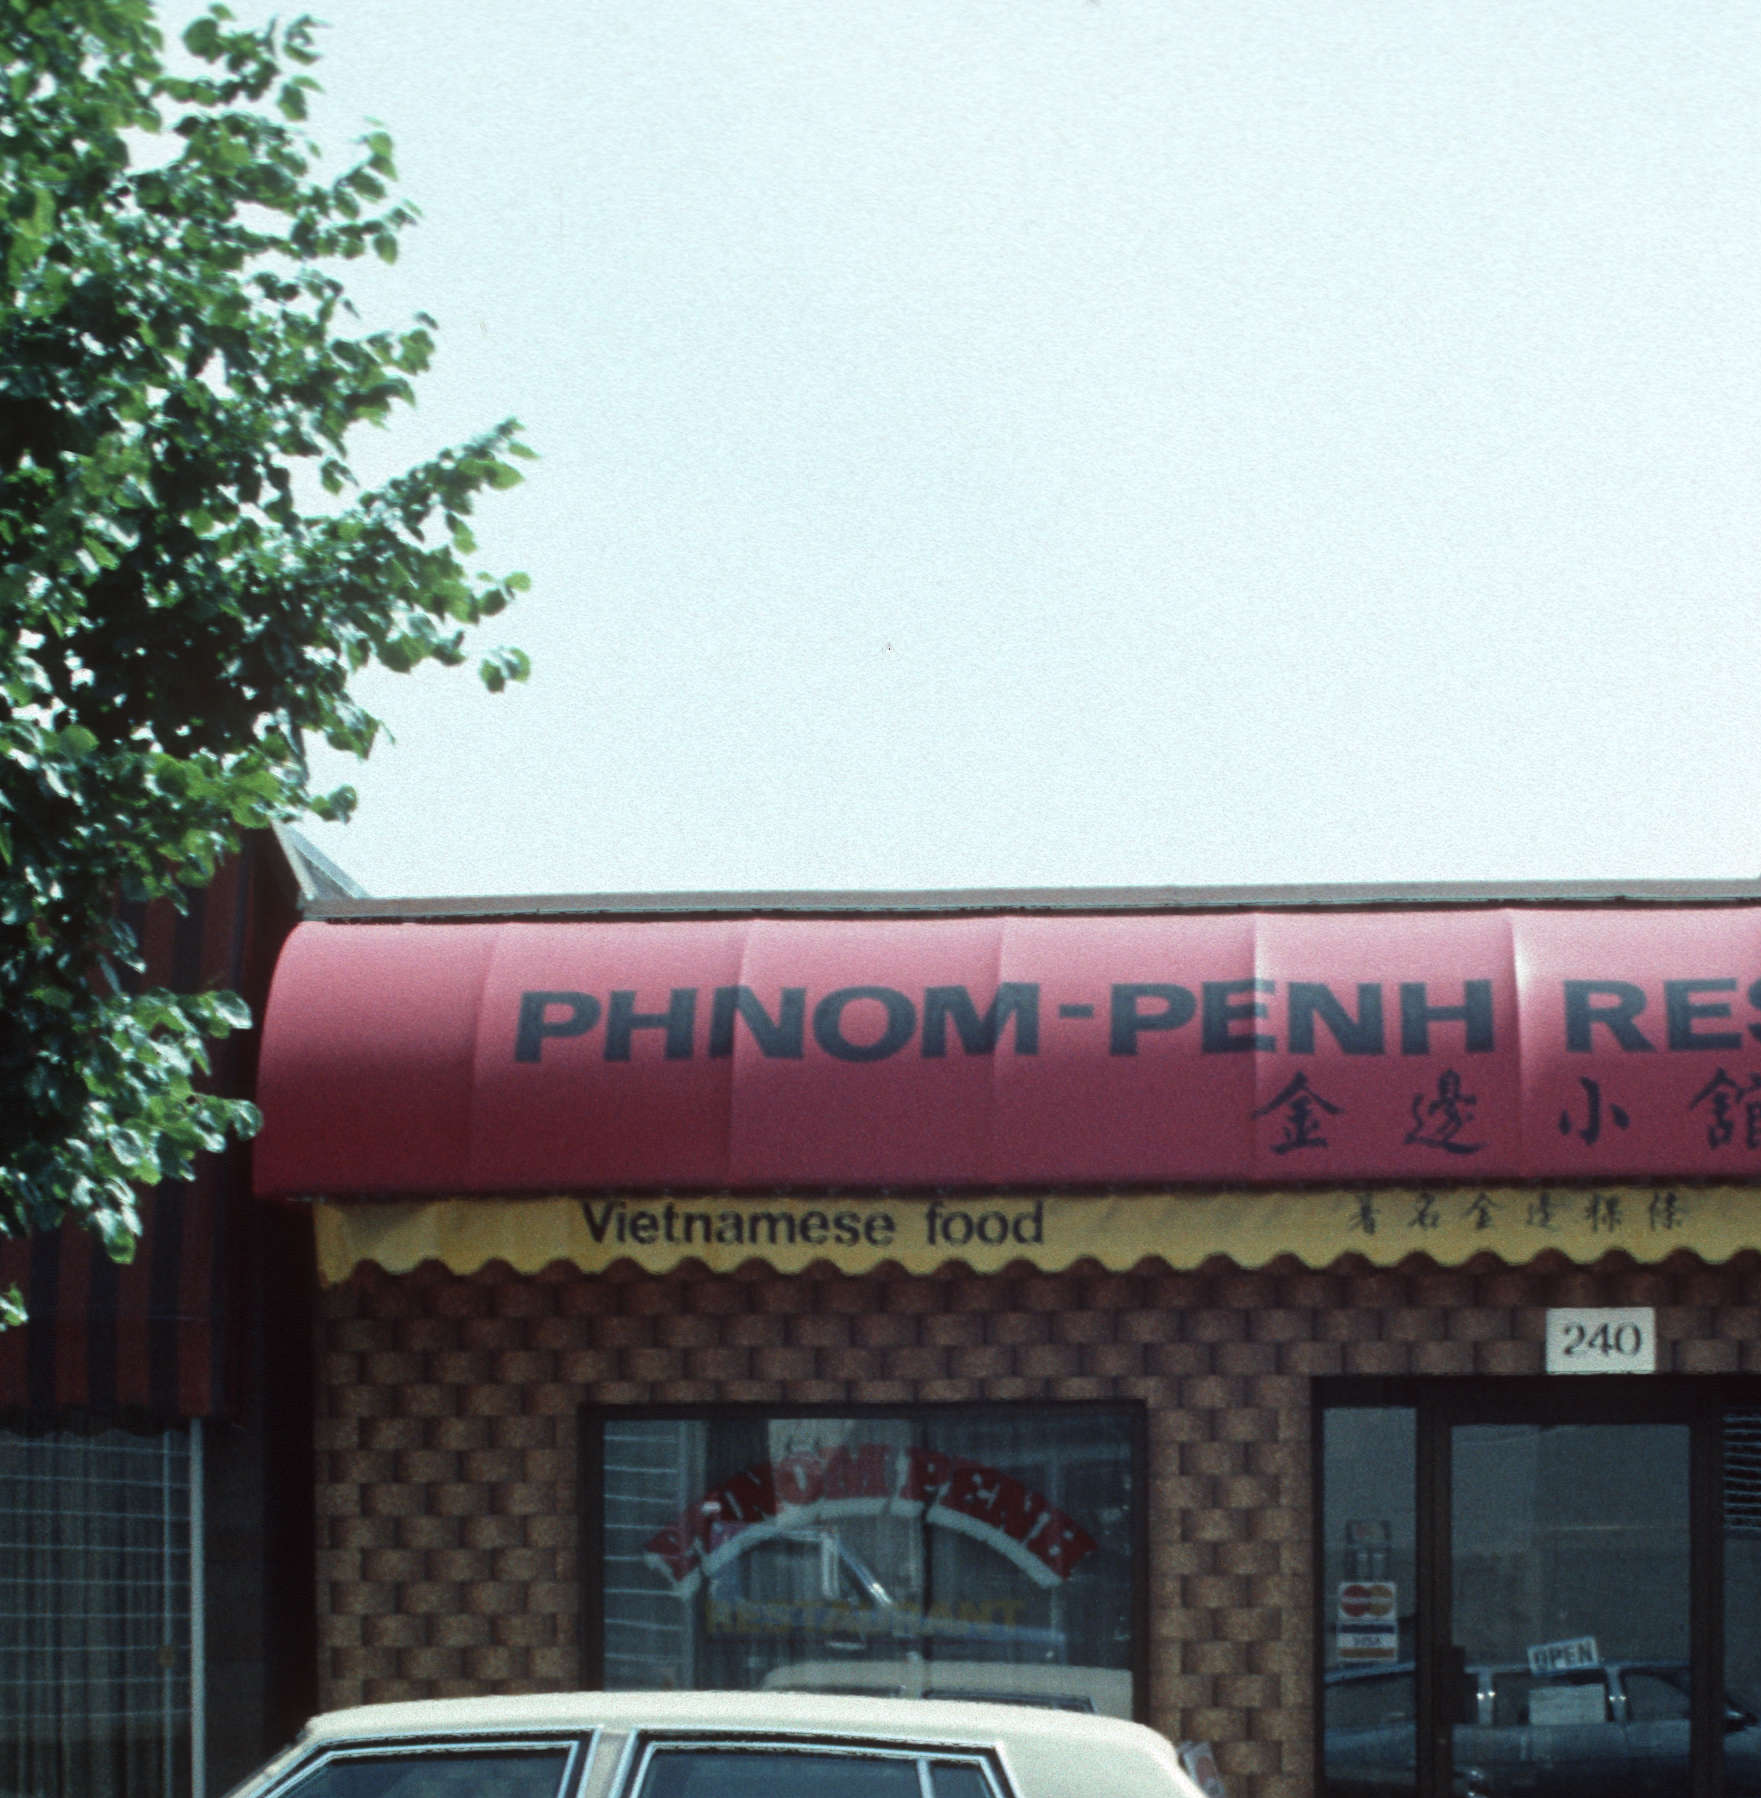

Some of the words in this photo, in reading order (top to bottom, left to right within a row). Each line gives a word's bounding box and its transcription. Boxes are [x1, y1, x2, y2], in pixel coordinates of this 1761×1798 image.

[516, 979, 1495, 1062] PHNOM-PENH
[582, 1196, 894, 1248] Vietnamese
[924, 1196, 1045, 1248] food
[1562, 1322, 1642, 1357] 240
[1534, 1641, 1594, 1672] OPEN
